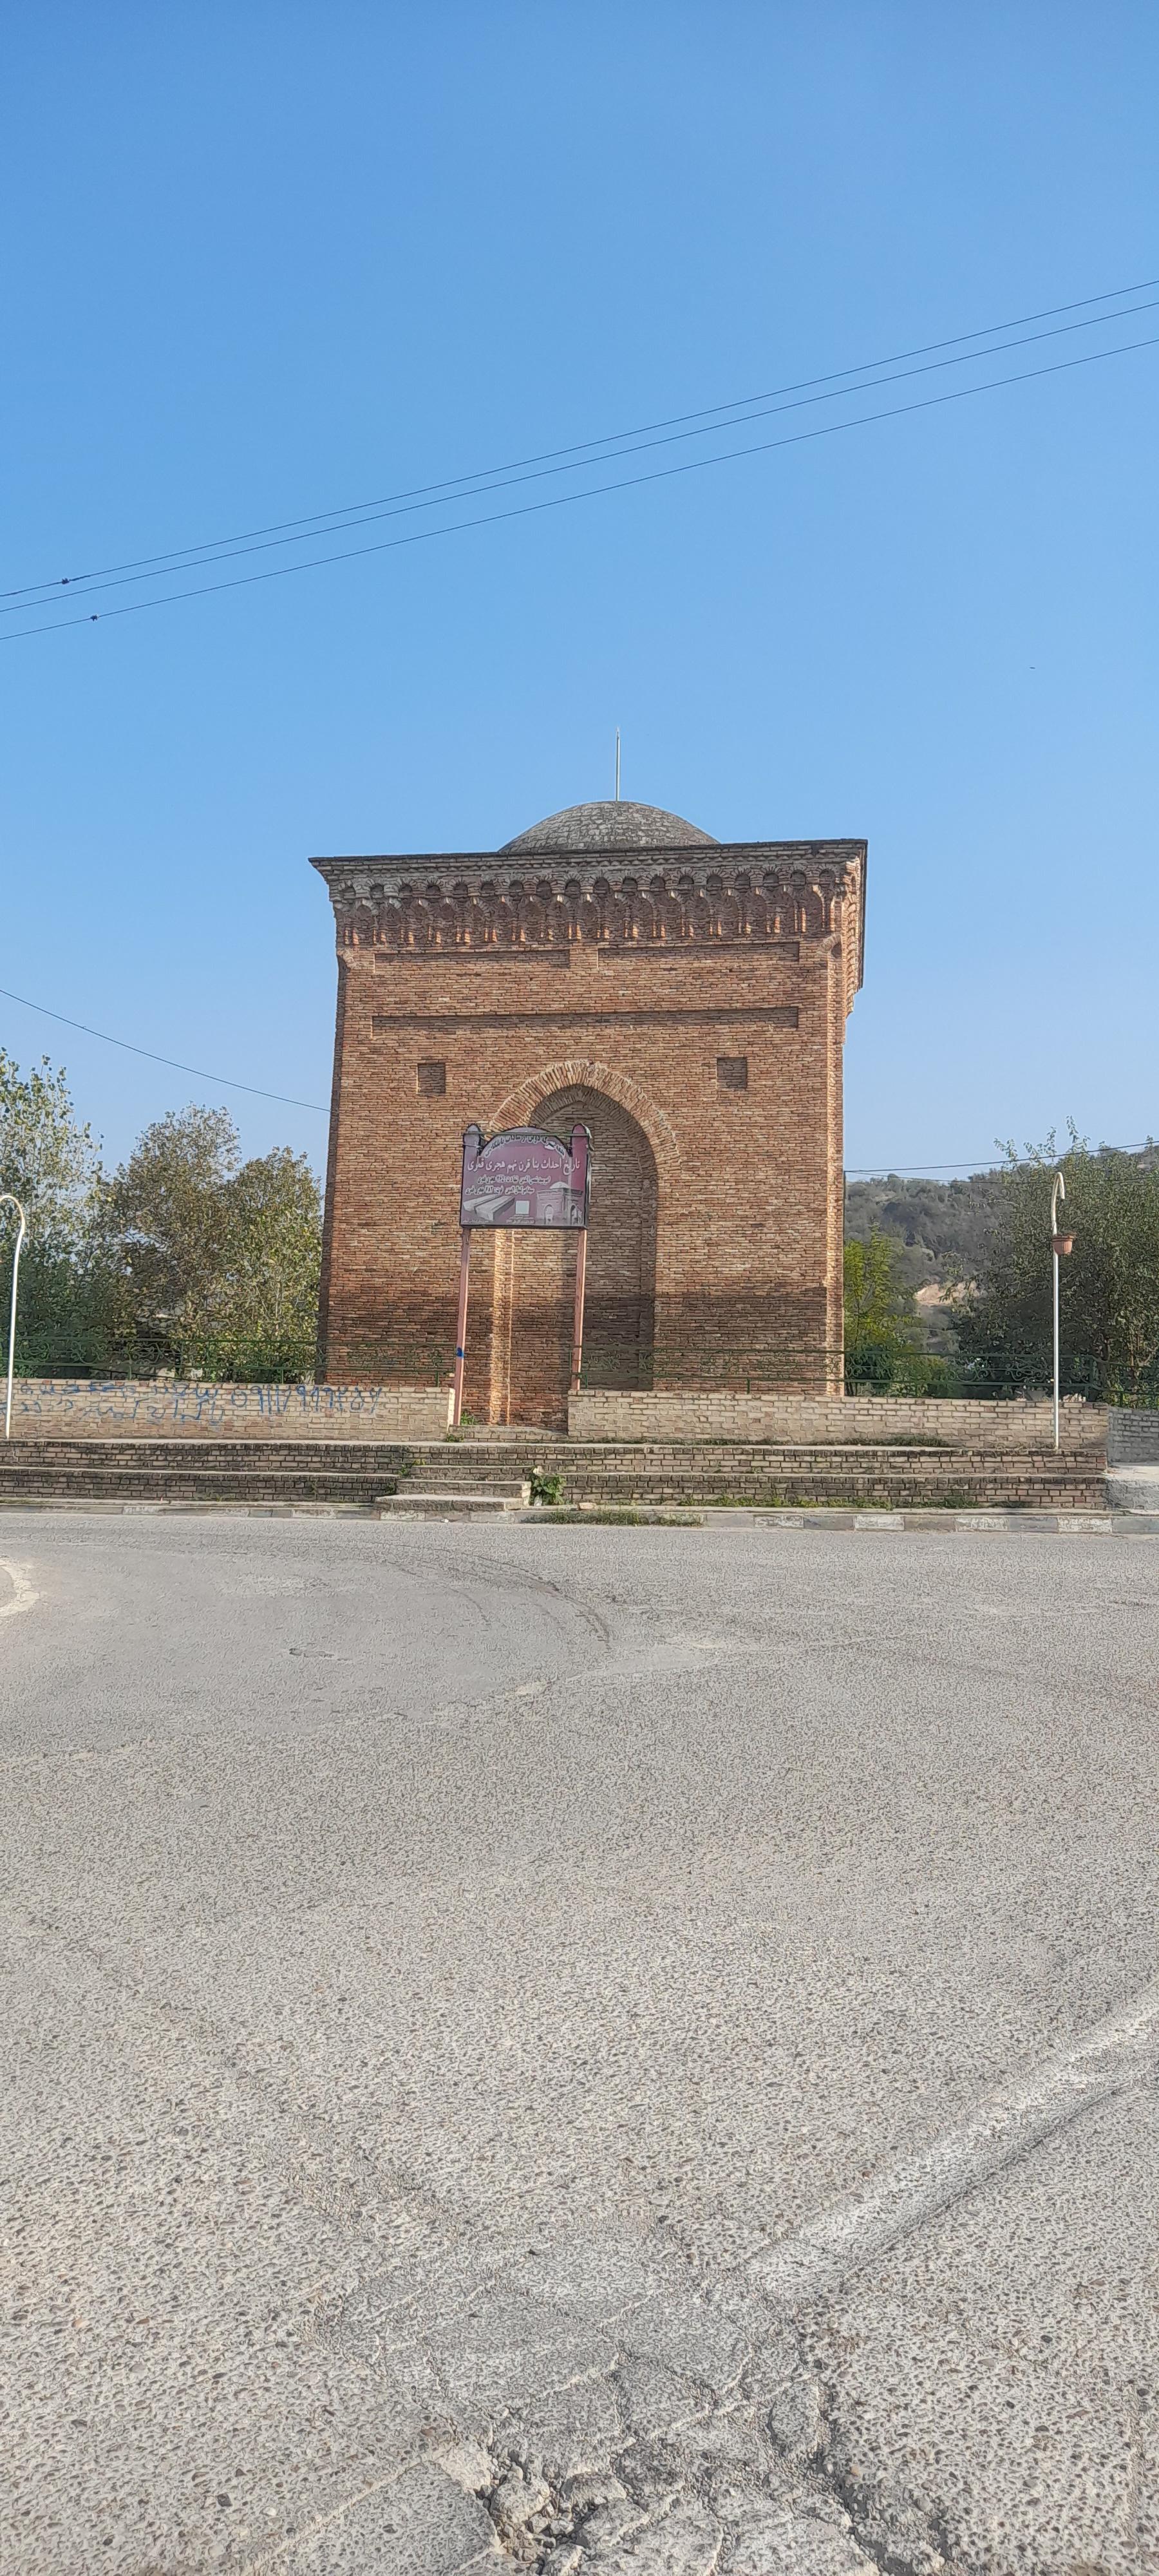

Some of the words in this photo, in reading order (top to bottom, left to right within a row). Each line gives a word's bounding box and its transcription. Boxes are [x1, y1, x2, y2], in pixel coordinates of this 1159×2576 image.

[467, 1158, 484, 1171] قمری
[485, 1160, 505, 1171] هجری
[507, 1160, 517, 1173] نهم
[518, 1159, 531, 1171] قرن
[542, 1158, 561, 1170] احداث
[563, 1158, 580, 1175] تاریخ
